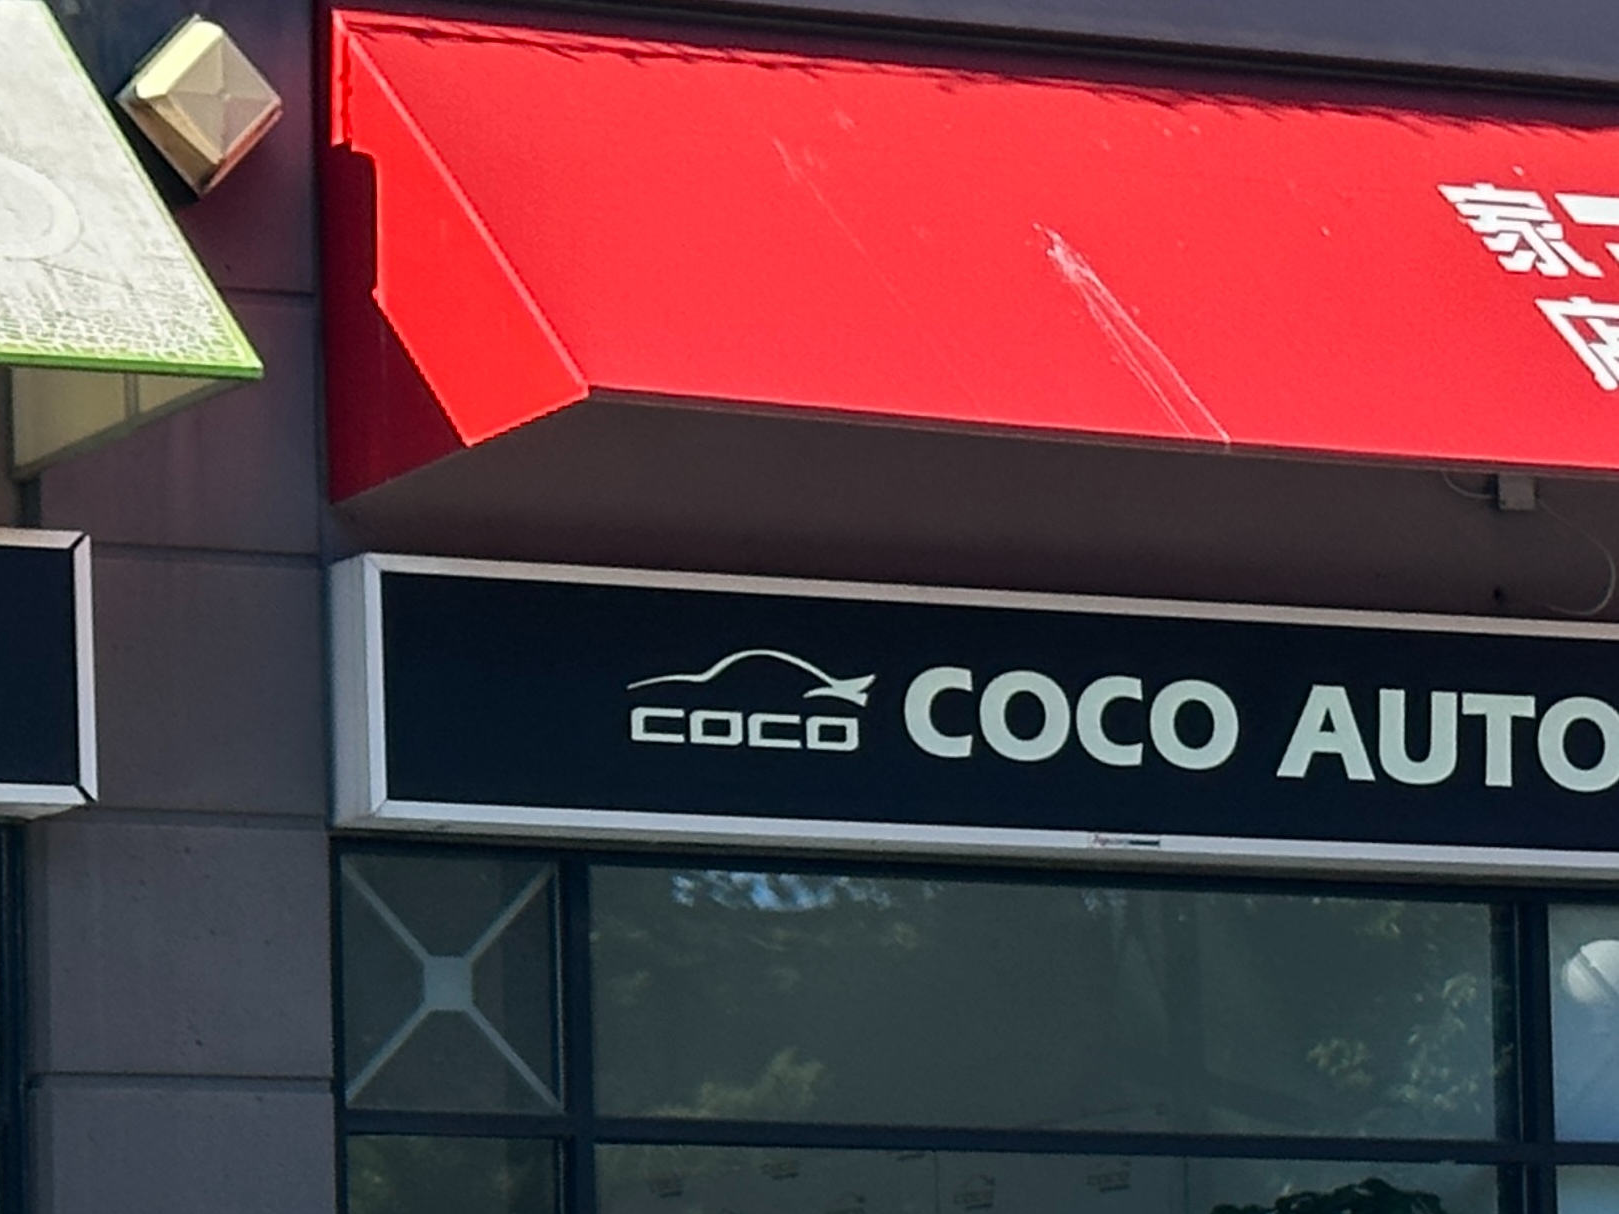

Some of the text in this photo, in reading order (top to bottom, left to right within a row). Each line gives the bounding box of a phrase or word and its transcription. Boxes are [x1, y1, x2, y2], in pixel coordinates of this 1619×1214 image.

[630, 706, 860, 752] COCO
[904, 666, 1619, 792] COCO AUTO
